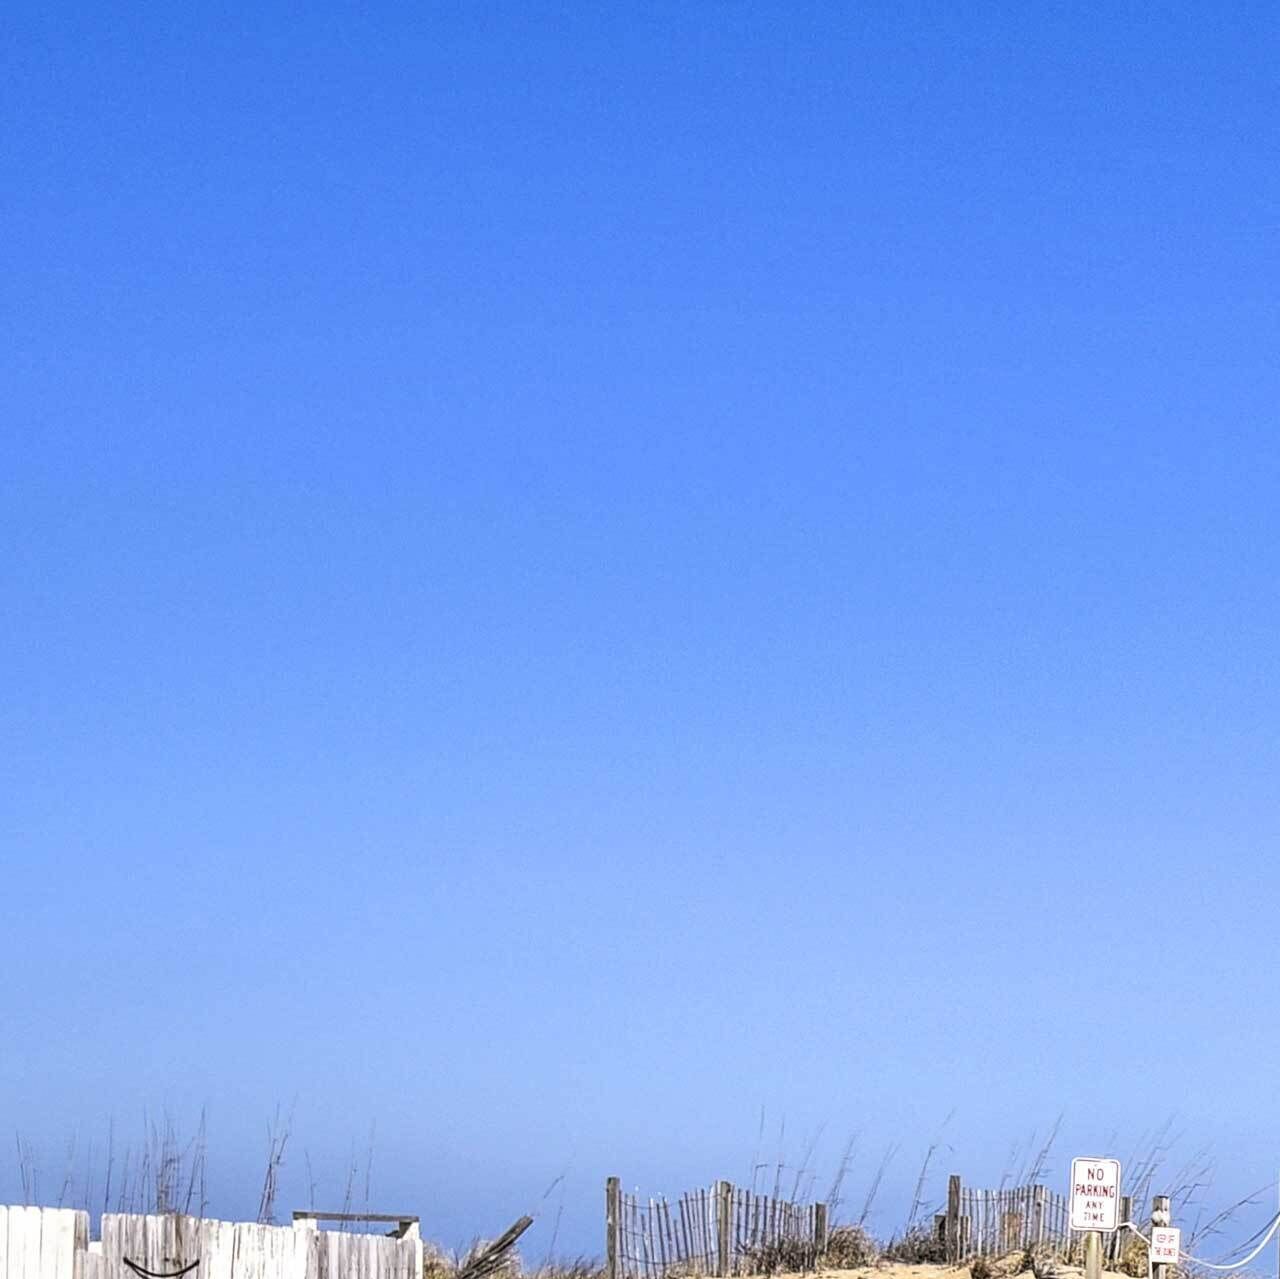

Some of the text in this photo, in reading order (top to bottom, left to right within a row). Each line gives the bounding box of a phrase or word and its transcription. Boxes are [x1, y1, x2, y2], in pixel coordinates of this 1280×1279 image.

[1087, 1168, 1104, 1181] NO
[1075, 1183, 1115, 1198] PARKING
[1085, 1201, 1104, 1209] ANY
[1084, 1212, 1104, 1222] TIME
